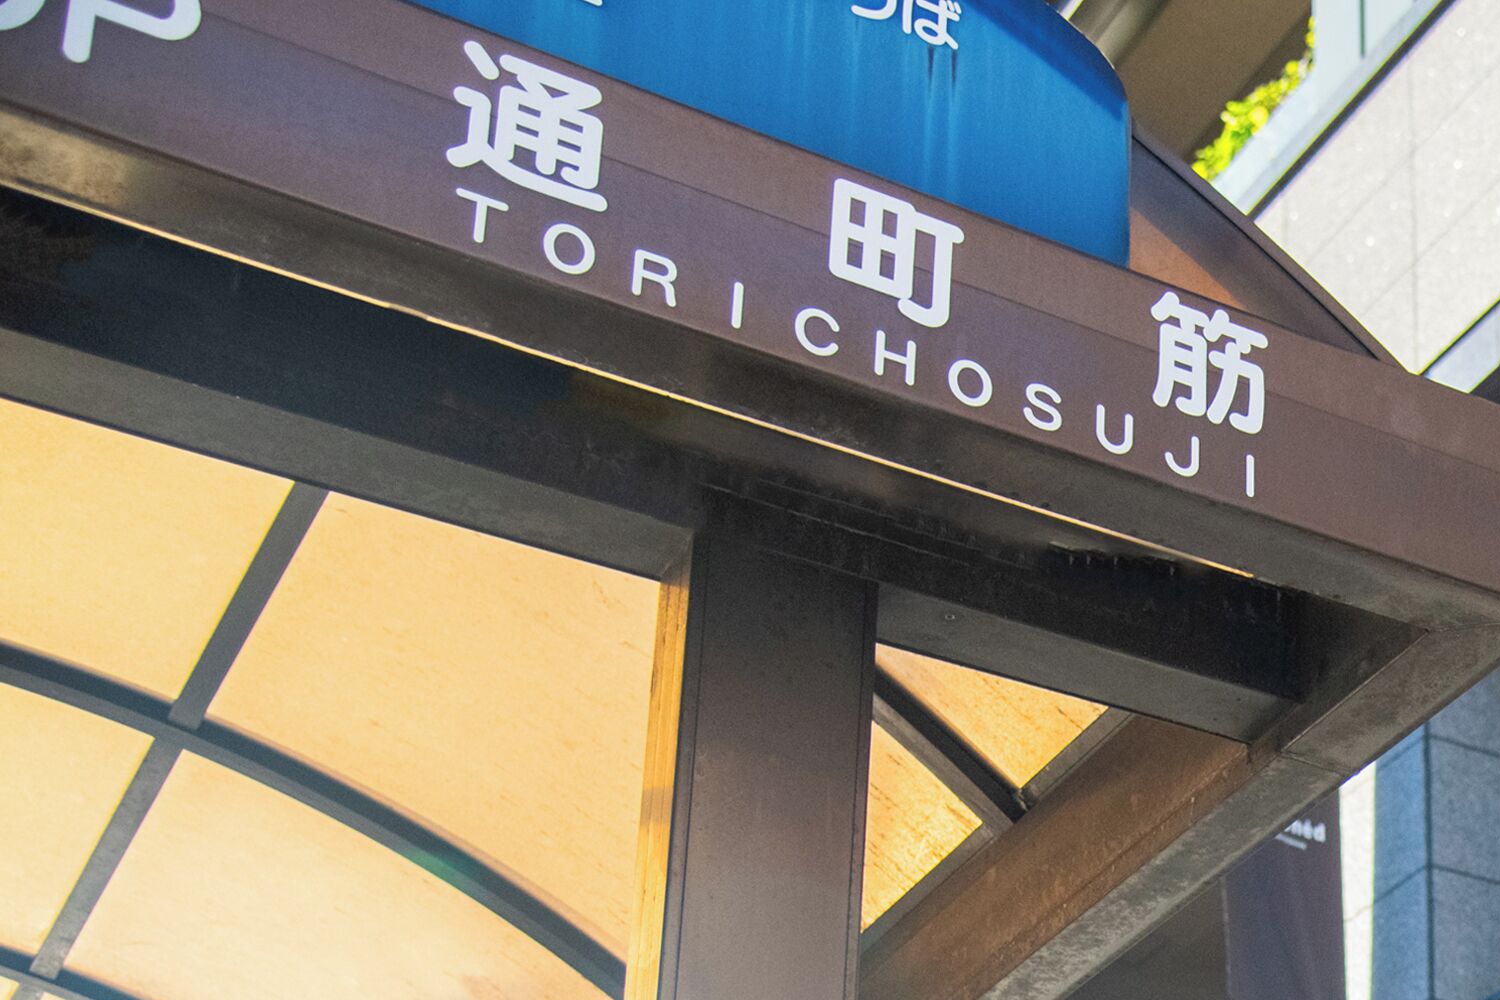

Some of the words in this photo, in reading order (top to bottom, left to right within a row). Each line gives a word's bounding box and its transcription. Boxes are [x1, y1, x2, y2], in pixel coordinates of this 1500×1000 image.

[446, 40, 1268, 434] 通町筋
[455, 187, 1256, 498] TORICHOSUJI
